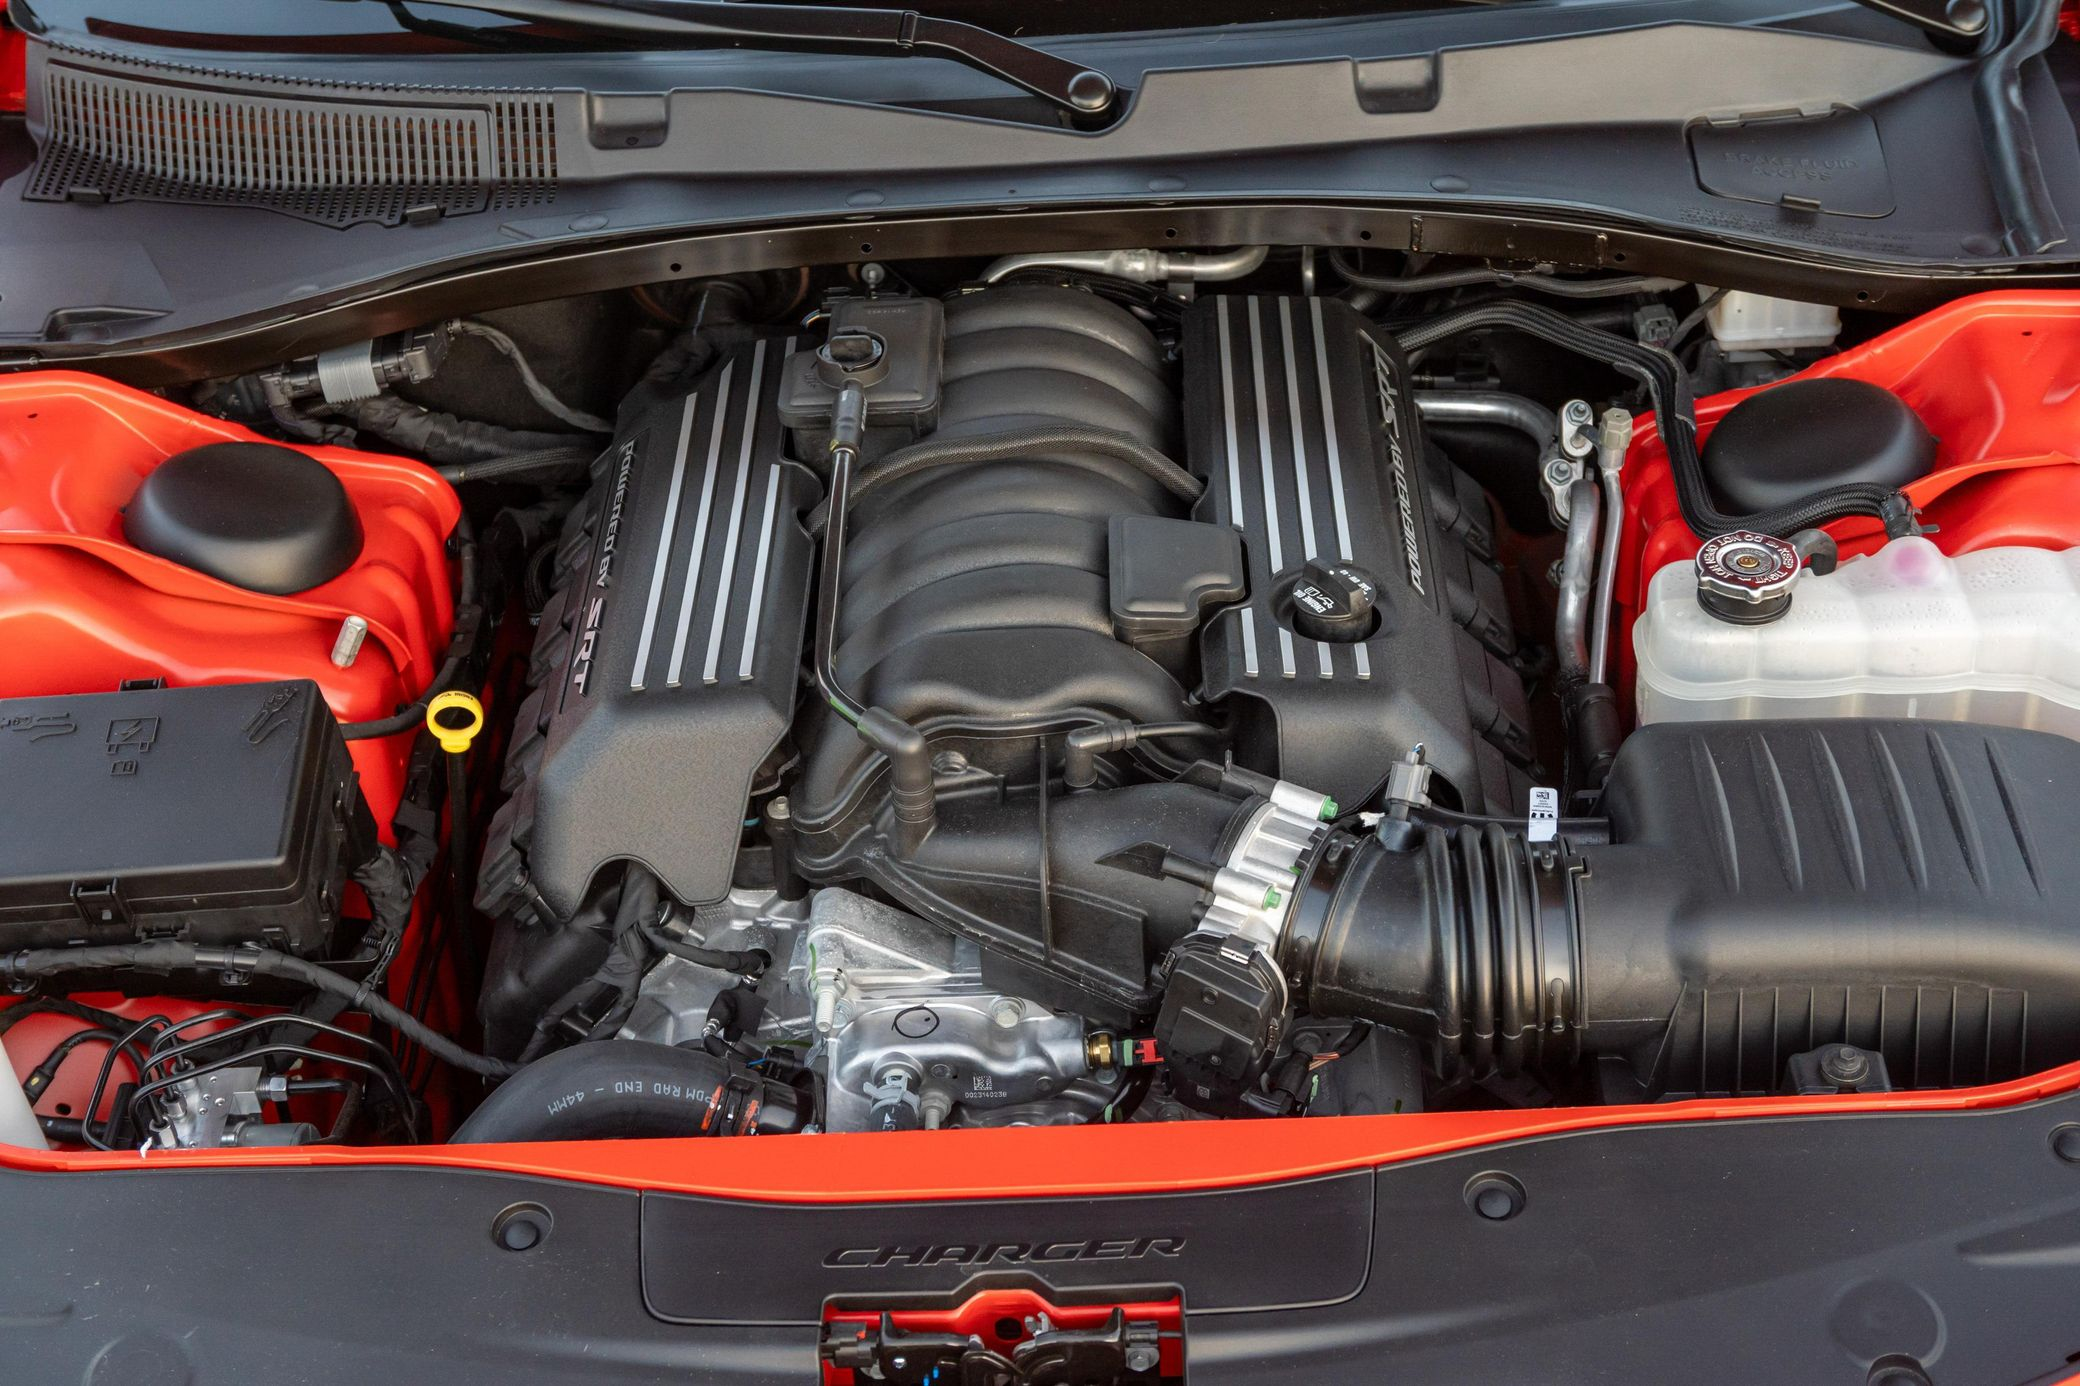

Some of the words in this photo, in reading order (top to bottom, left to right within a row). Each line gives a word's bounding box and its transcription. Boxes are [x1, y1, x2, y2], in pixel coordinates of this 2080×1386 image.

[1723, 152, 1793, 167] BRAKE
[1372, 342, 1400, 439] SRT
[1388, 434, 1406, 474] BY
[603, 440, 636, 553] POWERED
[1394, 470, 1425, 595] POWERED
[1717, 534, 1742, 546] NOT
[1744, 534, 1764, 543] DO
[1703, 544, 1719, 565] OPEN
[1778, 547, 1794, 568] KEEP
[596, 555, 612, 588] BY
[1708, 564, 1734, 578] HOT
[1755, 570, 1788, 584] TIGHT
[574, 597, 604, 696] SRT
[615, 1081, 643, 1093] END
[653, 1083, 681, 1098] RAD
[547, 1091, 585, 1116] 44MM
[821, 1236, 1187, 1268] CHARGER
